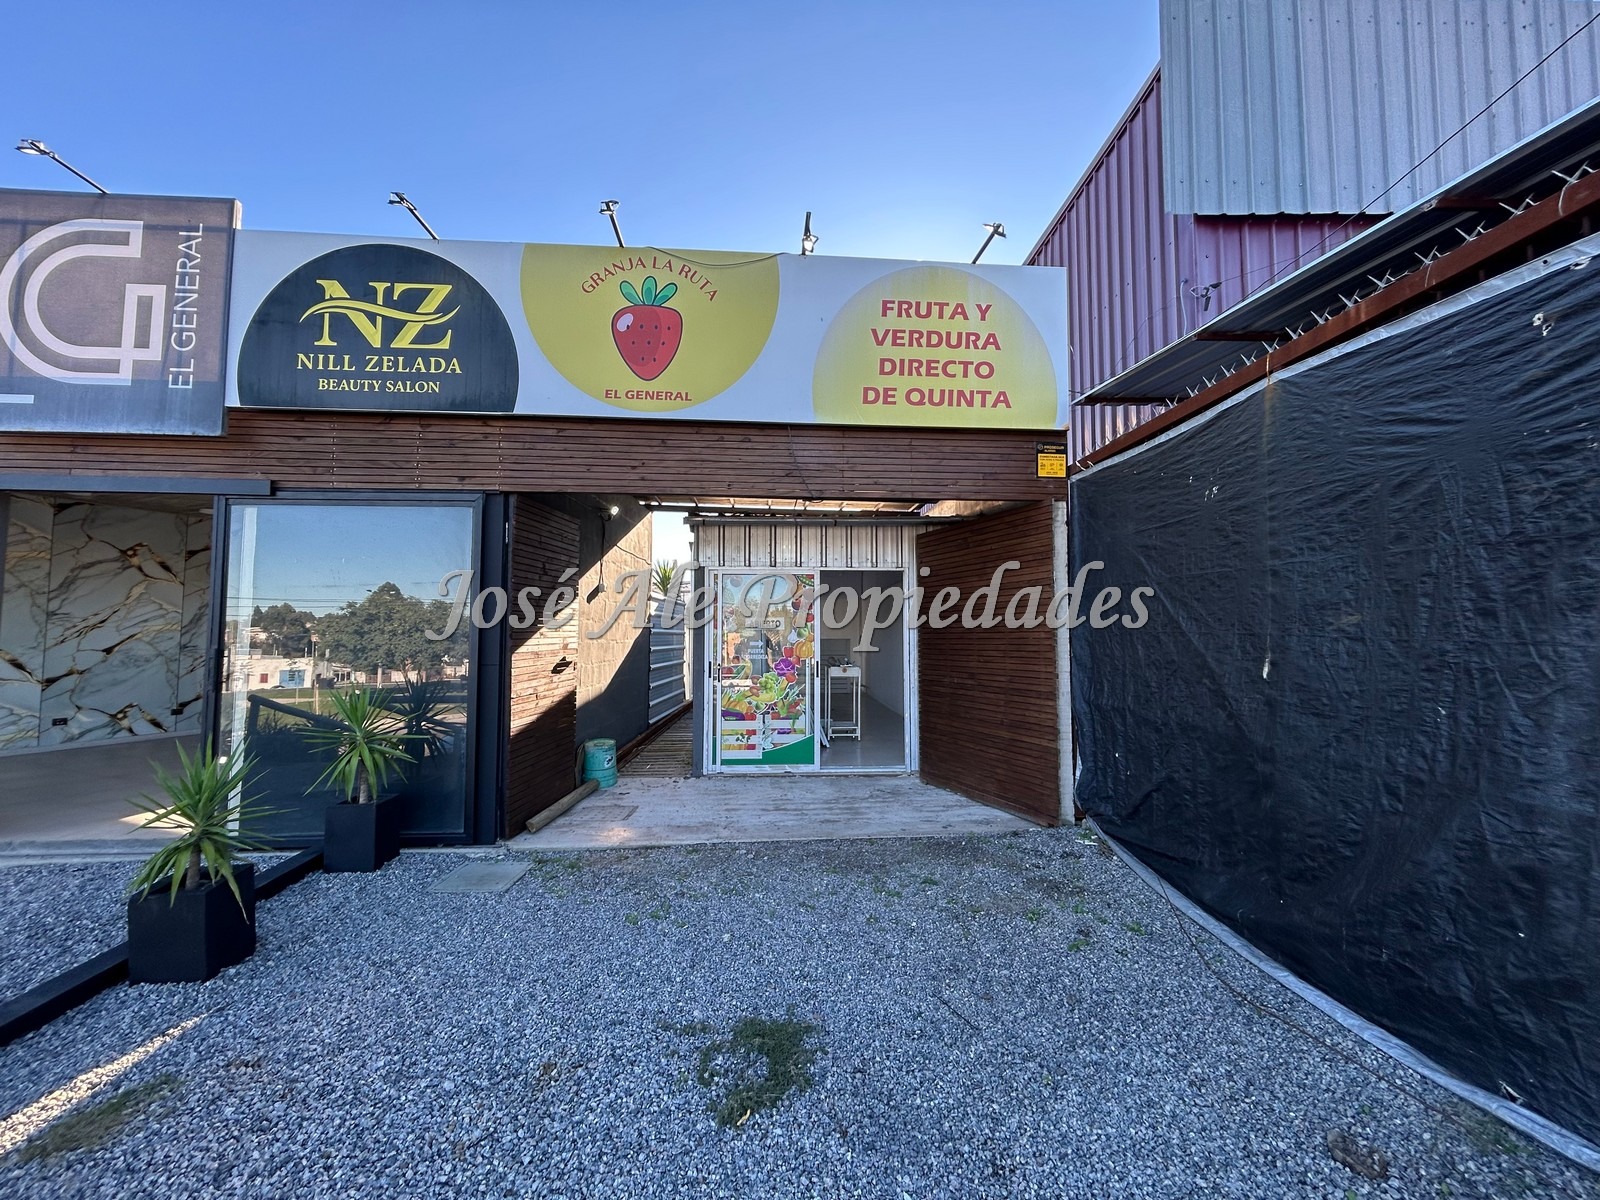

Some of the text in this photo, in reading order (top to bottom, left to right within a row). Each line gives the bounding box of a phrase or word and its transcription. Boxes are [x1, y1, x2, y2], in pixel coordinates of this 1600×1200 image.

[581, 256, 719, 302] GRANJA LA RUTA
[168, 222, 204, 389] EL GENERAL
[313, 279, 453, 350] NZ
[880, 299, 993, 322] FRUTA Y
[870, 328, 1002, 351] VERDURA
[296, 353, 463, 374] NILL ZELADA
[878, 357, 995, 380] DIRECTO
[317, 378, 441, 393] BEAUTY SALON
[604, 389, 693, 402] EL GENERAL
[862, 386, 1012, 409] DE QUINTA
